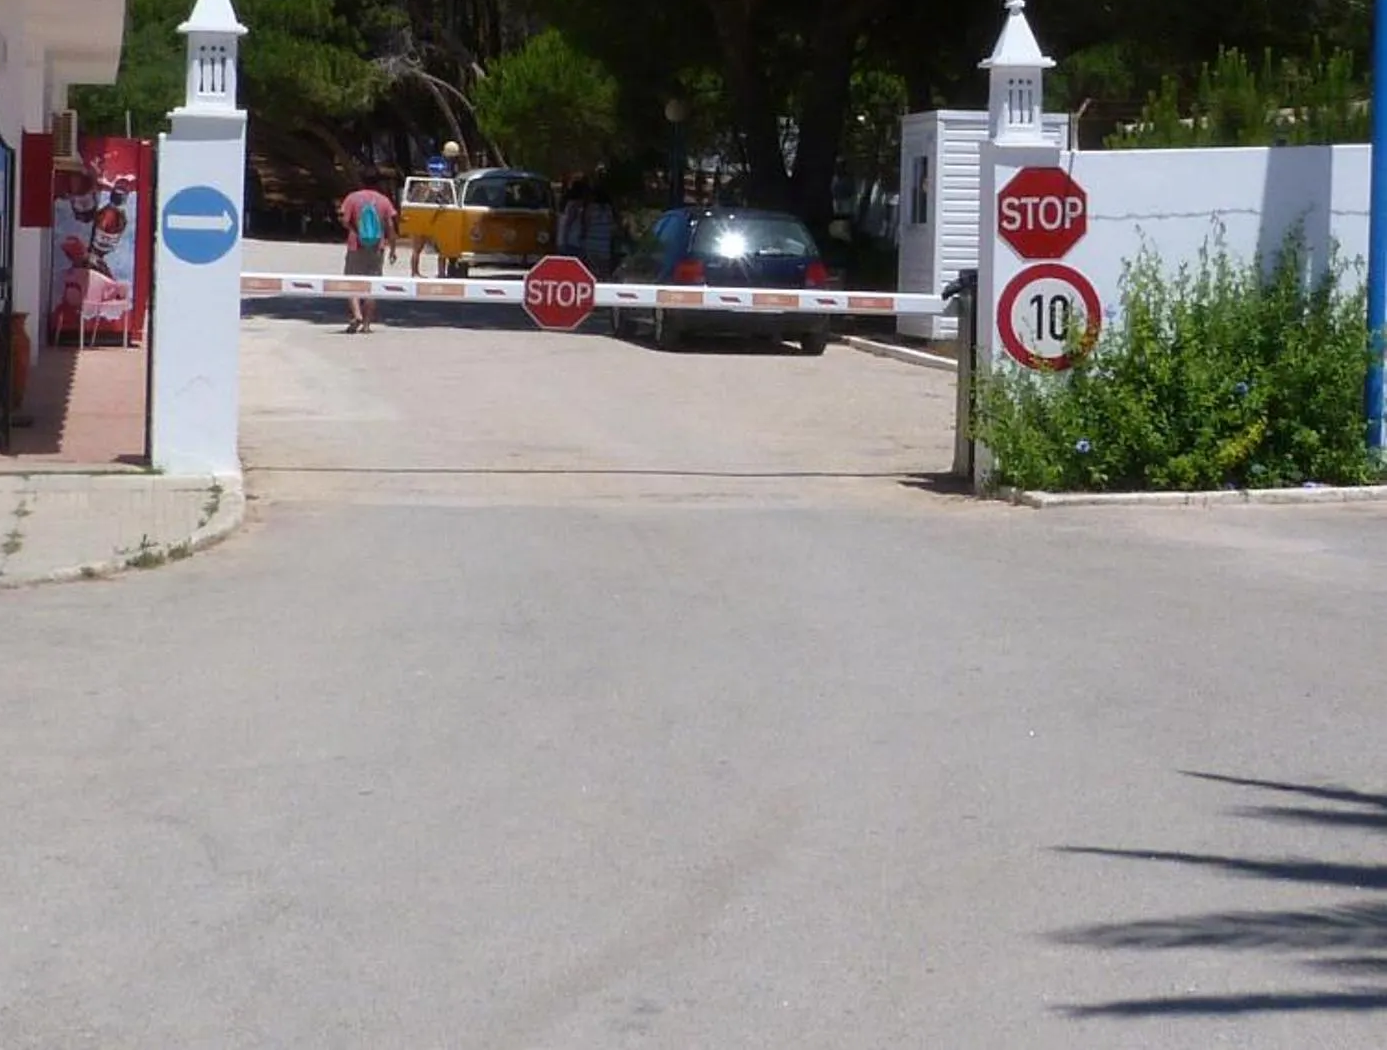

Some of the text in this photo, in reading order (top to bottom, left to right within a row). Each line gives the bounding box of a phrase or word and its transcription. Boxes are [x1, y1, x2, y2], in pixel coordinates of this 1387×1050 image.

[1001, 197, 1083, 232] STOP
[527, 281, 592, 306] STOP
[1030, 294, 1069, 341] 10
